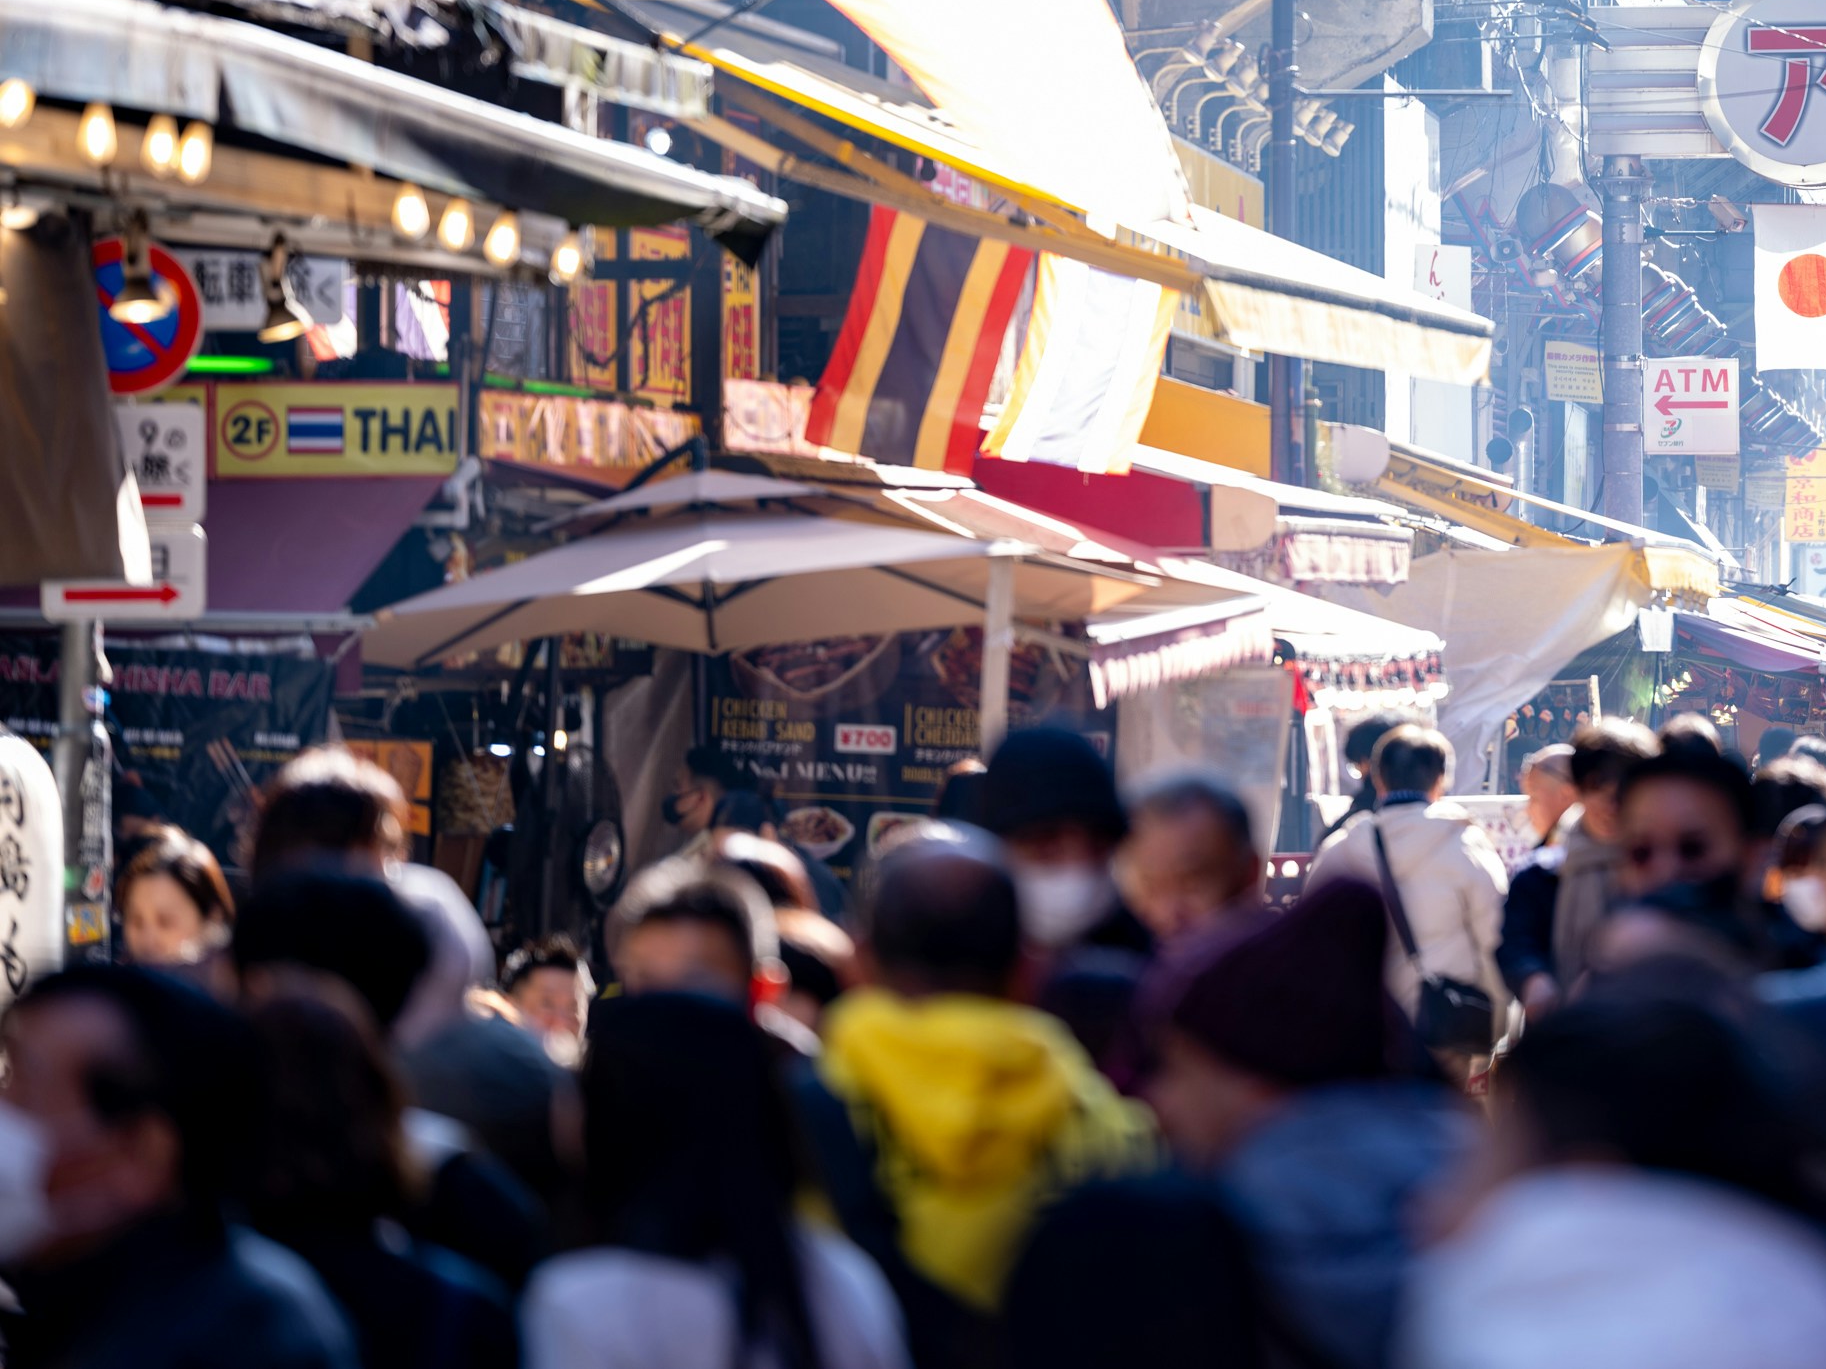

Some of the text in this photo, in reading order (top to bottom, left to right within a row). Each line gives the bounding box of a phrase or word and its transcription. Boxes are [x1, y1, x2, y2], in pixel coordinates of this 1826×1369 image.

[1654, 368, 1729, 393] ATM
[231, 416, 271, 446] 2F
[353, 409, 457, 454] THAI
[208, 670, 272, 700] BAR
[722, 698, 788, 720] CHICKEN
[840, 729, 893, 749] ¥700
